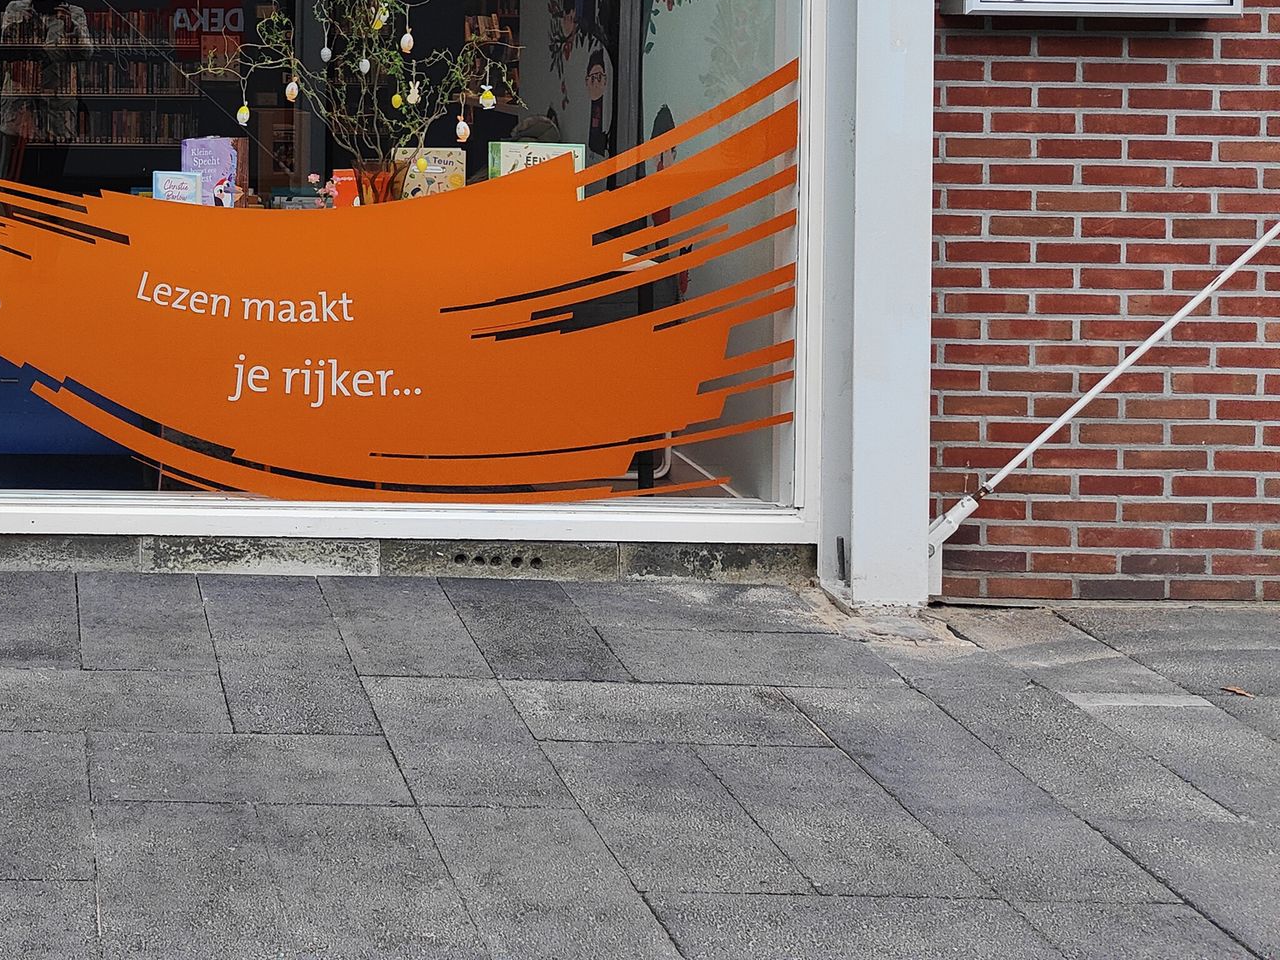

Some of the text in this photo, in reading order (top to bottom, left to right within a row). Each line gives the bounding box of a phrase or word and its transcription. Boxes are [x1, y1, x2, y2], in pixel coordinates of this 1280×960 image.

[191, 148, 212, 156] Kleine
[193, 157, 221, 168] Specht
[433, 156, 455, 167] Teun
[136, 271, 354, 324] Lezen maakt
[227, 353, 270, 403] je
